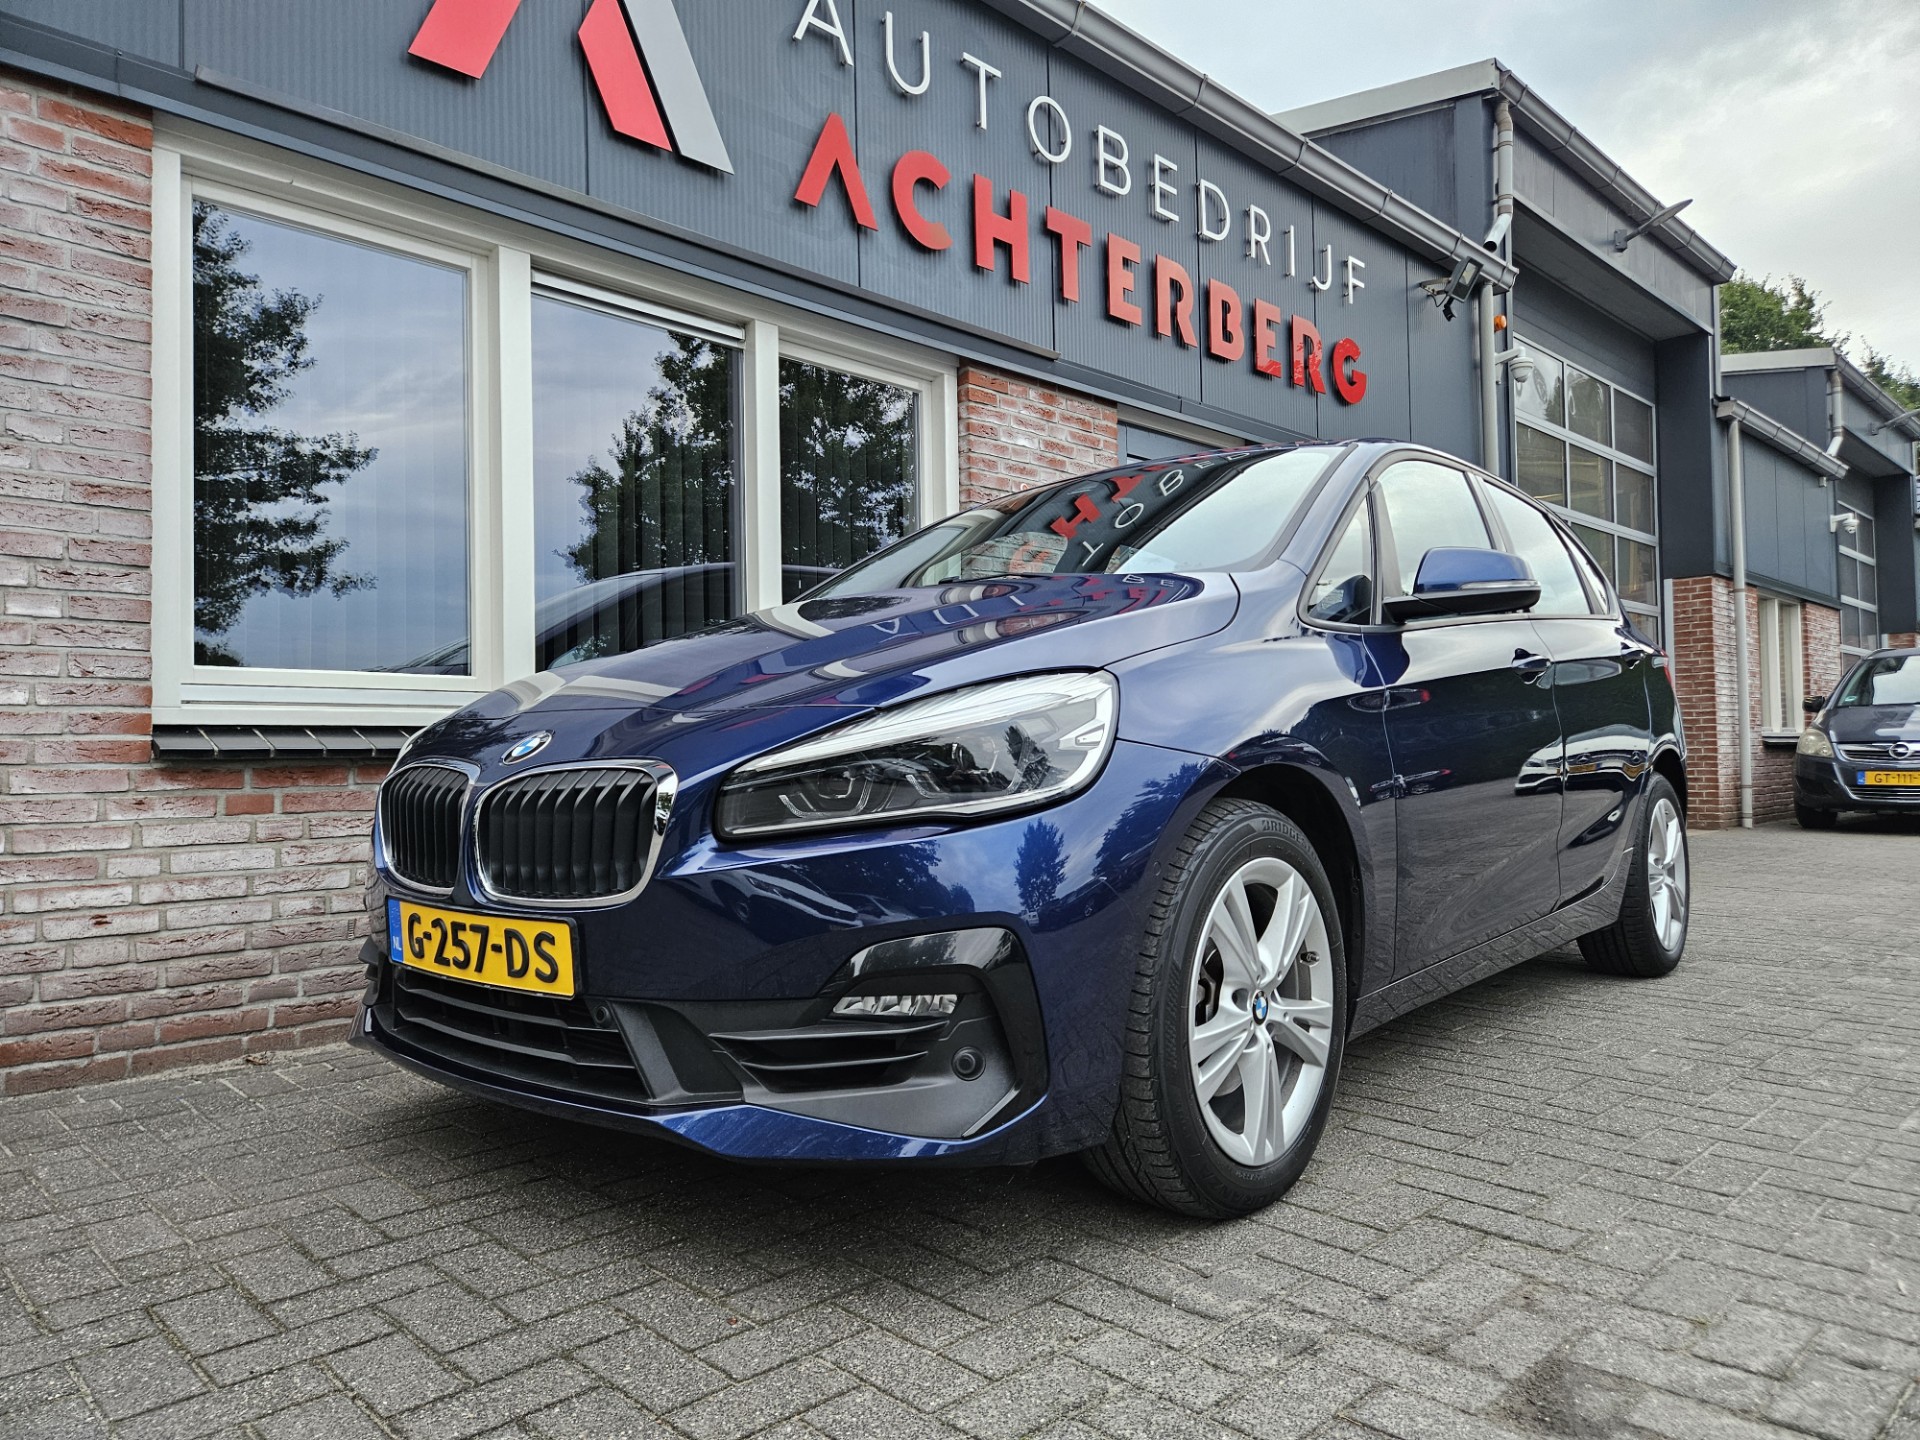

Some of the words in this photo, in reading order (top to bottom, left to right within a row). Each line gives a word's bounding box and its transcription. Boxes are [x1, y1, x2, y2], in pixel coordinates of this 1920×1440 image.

[793, 0, 1366, 304] AUTOBEDRIJF
[794, 111, 1368, 405] ACHTERBERG
[1874, 773, 1920, 783] GT-111-
[407, 912, 559, 983] G-257-DS
